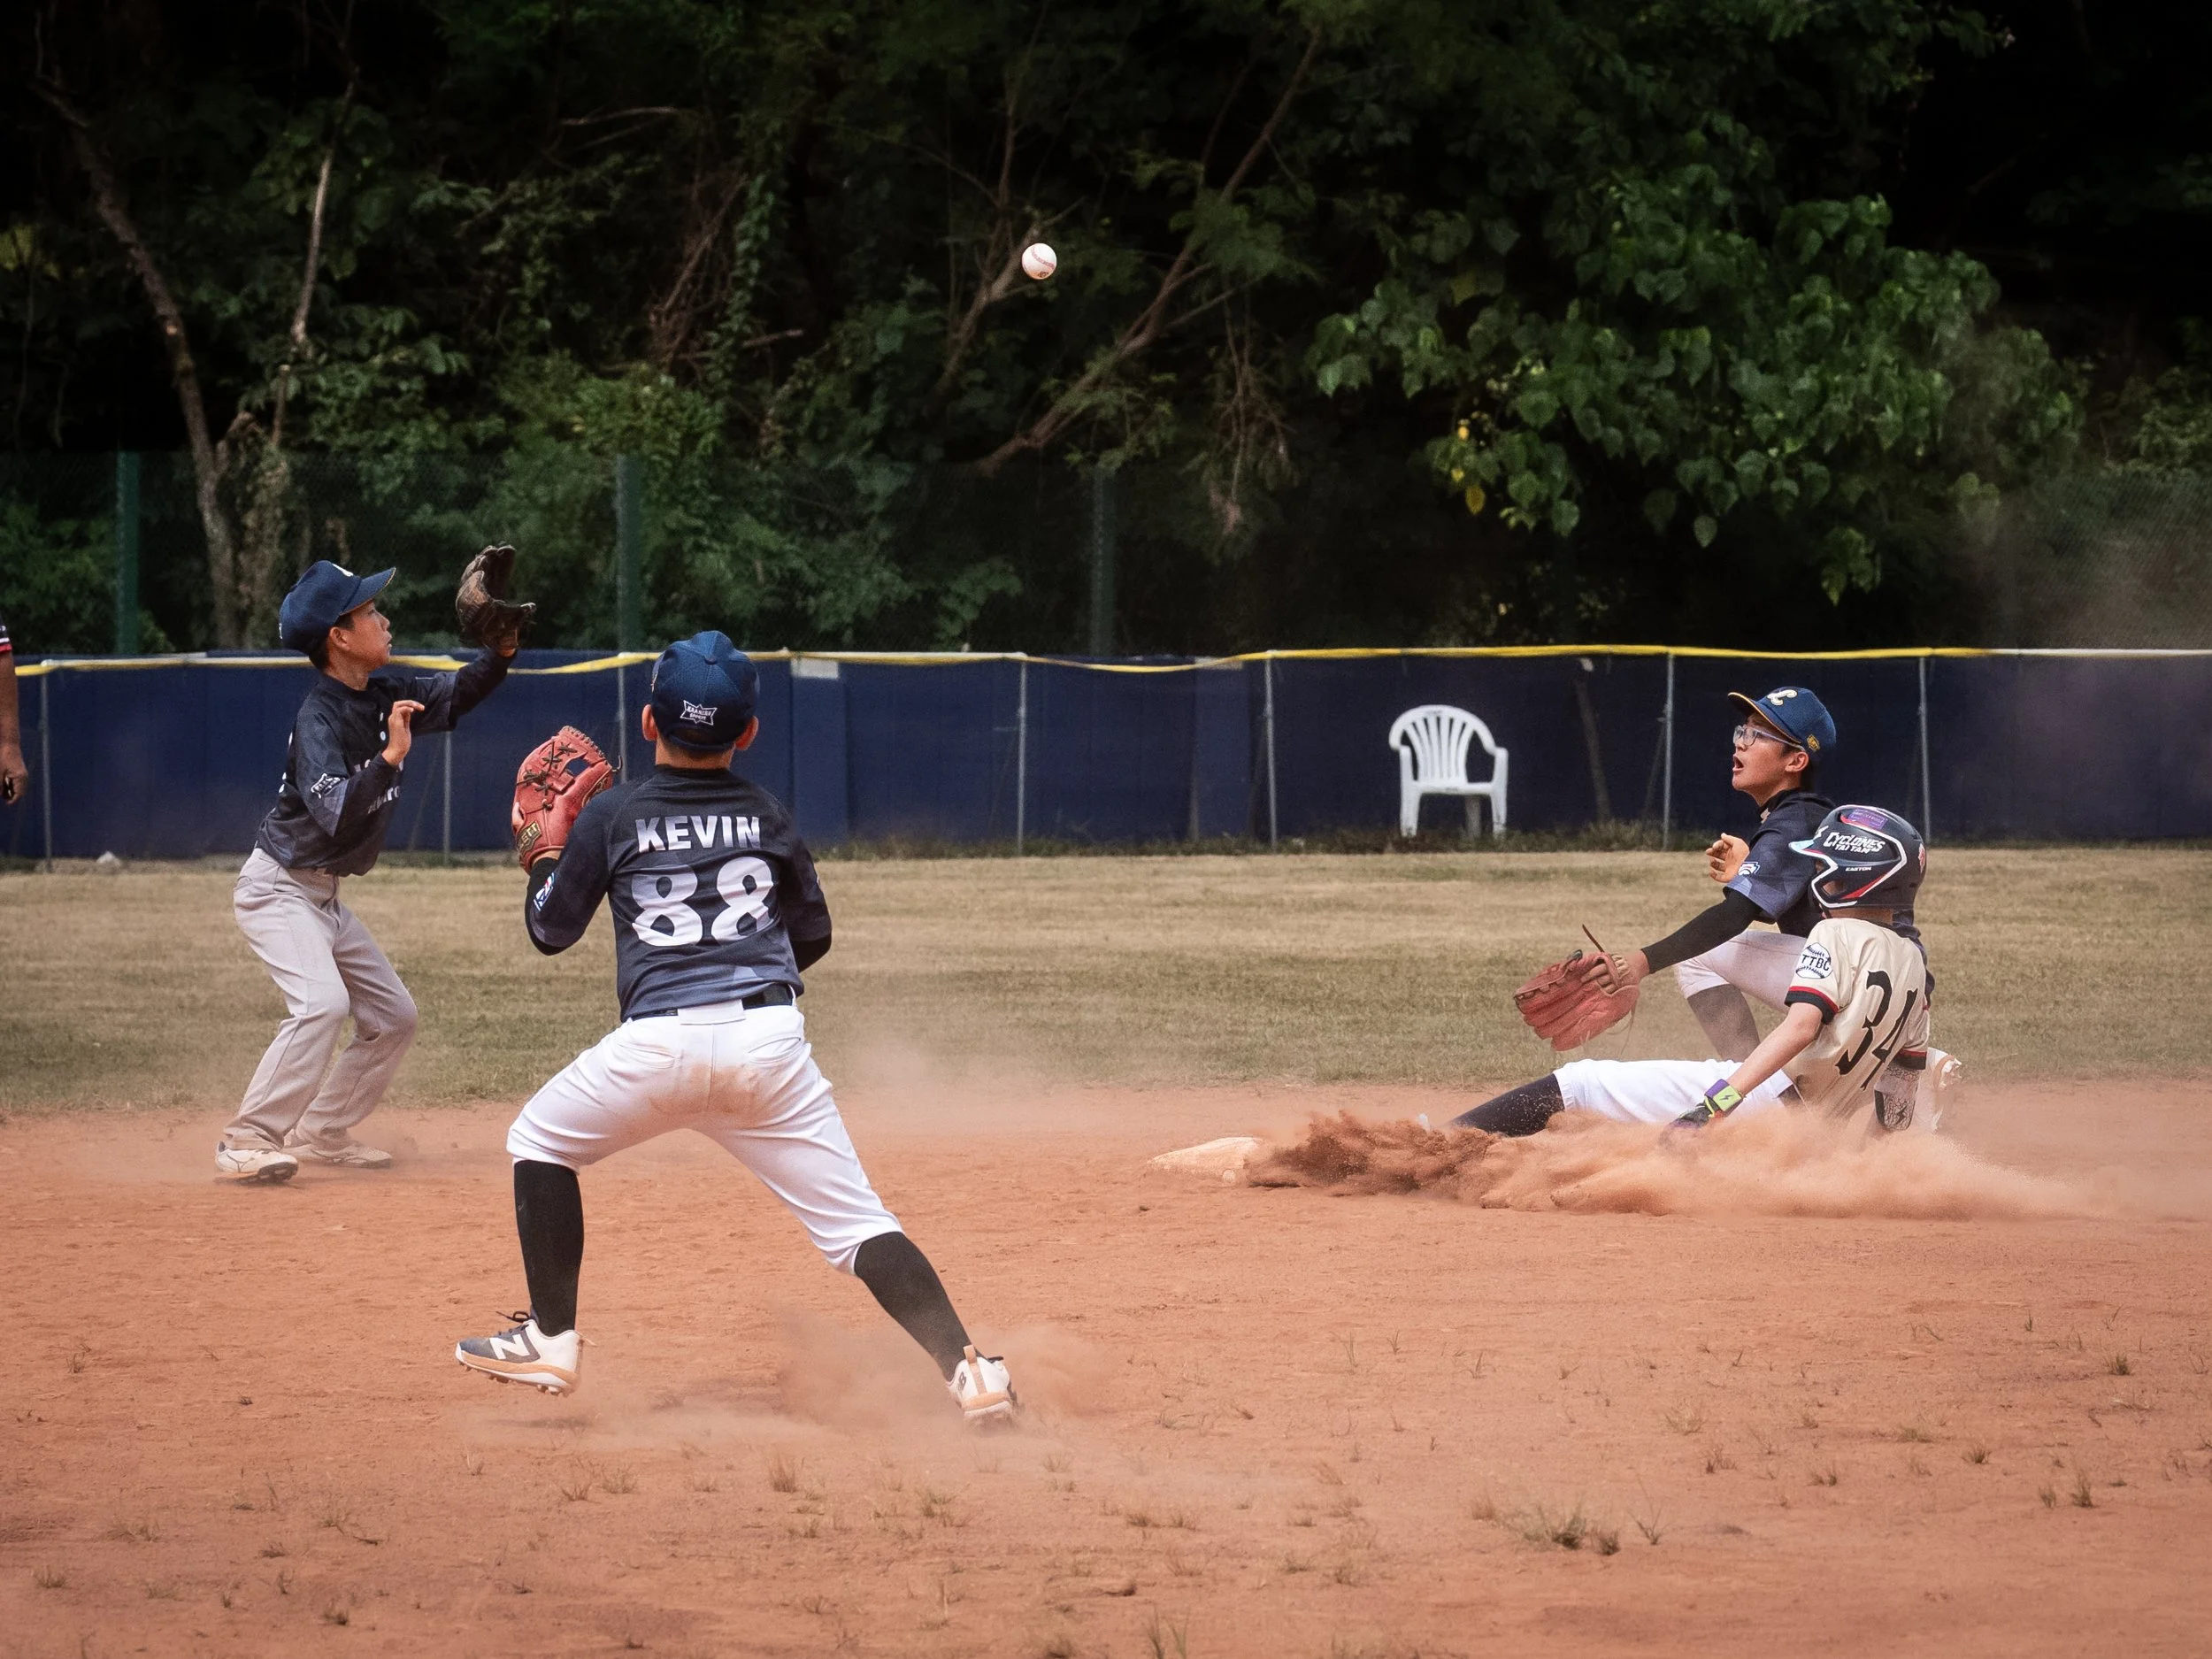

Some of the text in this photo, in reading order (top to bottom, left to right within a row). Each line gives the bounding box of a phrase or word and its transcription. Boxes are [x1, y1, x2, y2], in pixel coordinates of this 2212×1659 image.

[635, 815, 761, 853] KEVIN
[1823, 832, 1886, 852] CYCLONES
[631, 856, 774, 947] 88
[1801, 954, 1830, 972] TTBC
[1835, 970, 1918, 1091] 34
[489, 1333, 531, 1360] N
